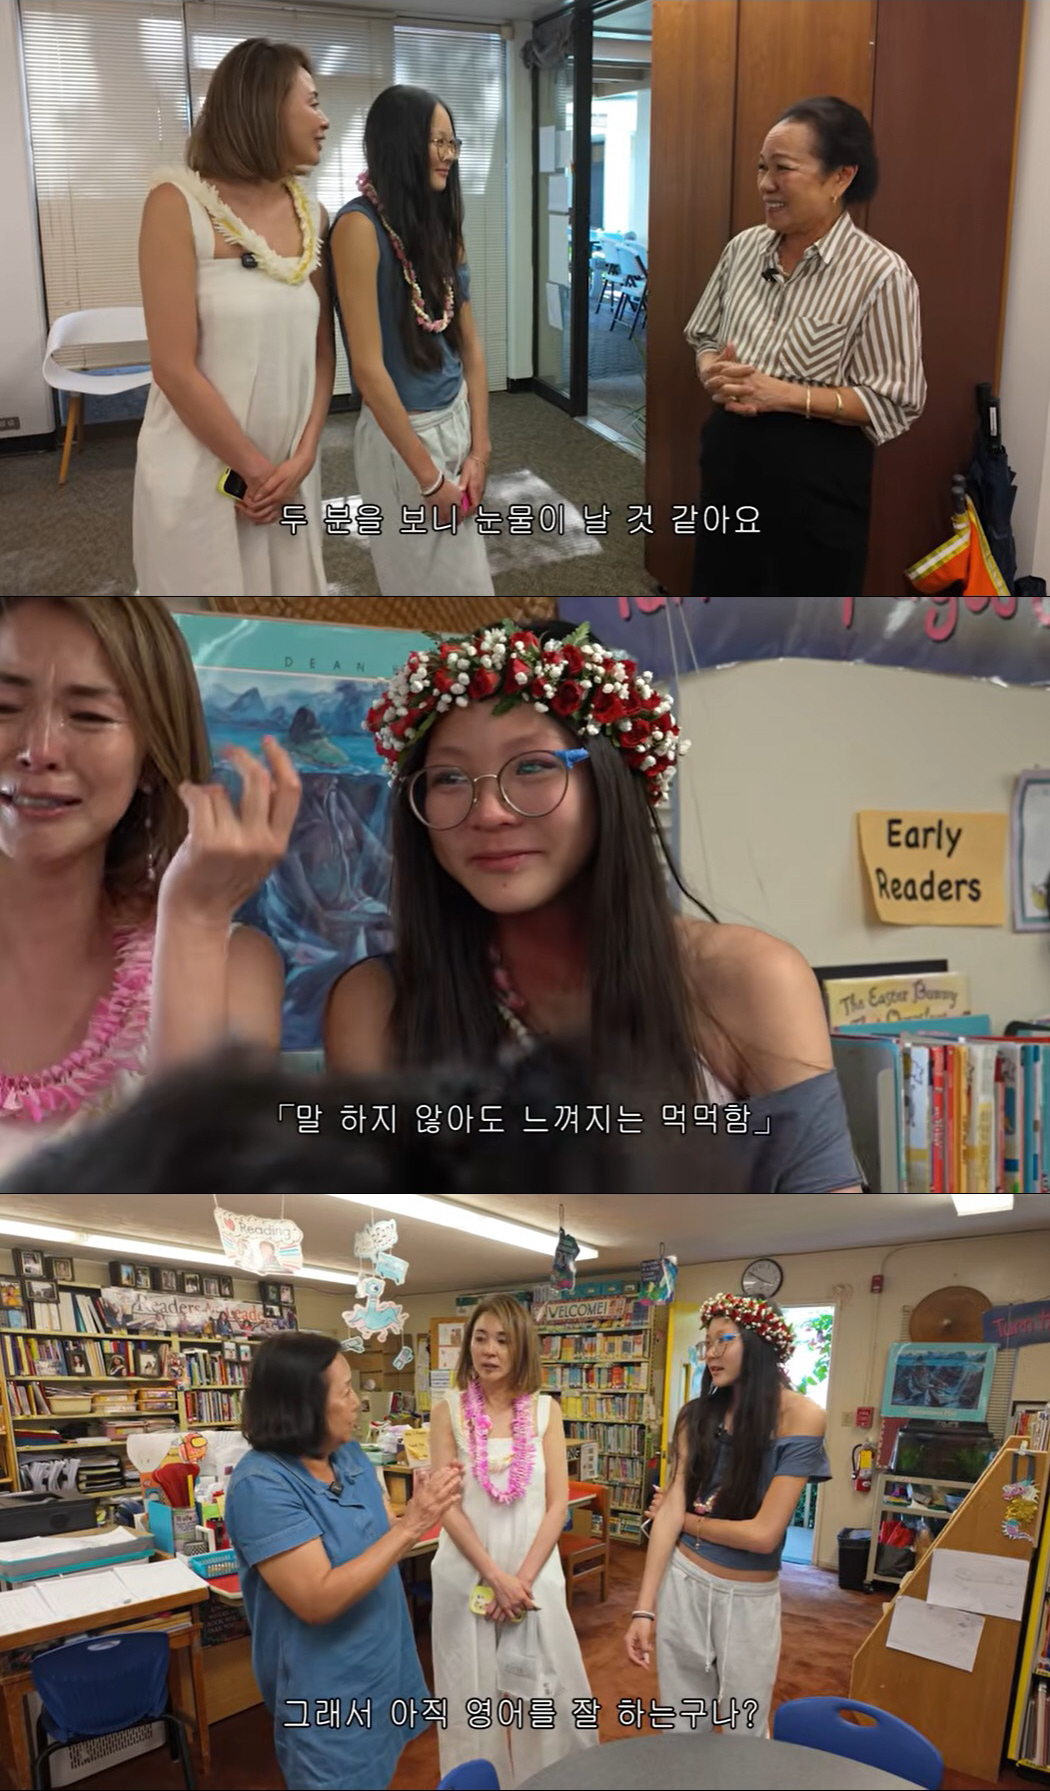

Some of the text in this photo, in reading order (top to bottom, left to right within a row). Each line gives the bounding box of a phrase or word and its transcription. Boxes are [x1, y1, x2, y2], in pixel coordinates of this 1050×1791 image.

[284, 655, 365, 673] DEAN
[887, 818, 963, 858] Early
[875, 867, 982, 903] Readers
[839, 993, 866, 1017] The
[867, 986, 909, 1008] Easter
[912, 979, 959, 1010] Bunny
[239, 1221, 291, 1241] Reading
[132, 1293, 201, 1314] Readers
[548, 1300, 609, 1320] WELCOME!
